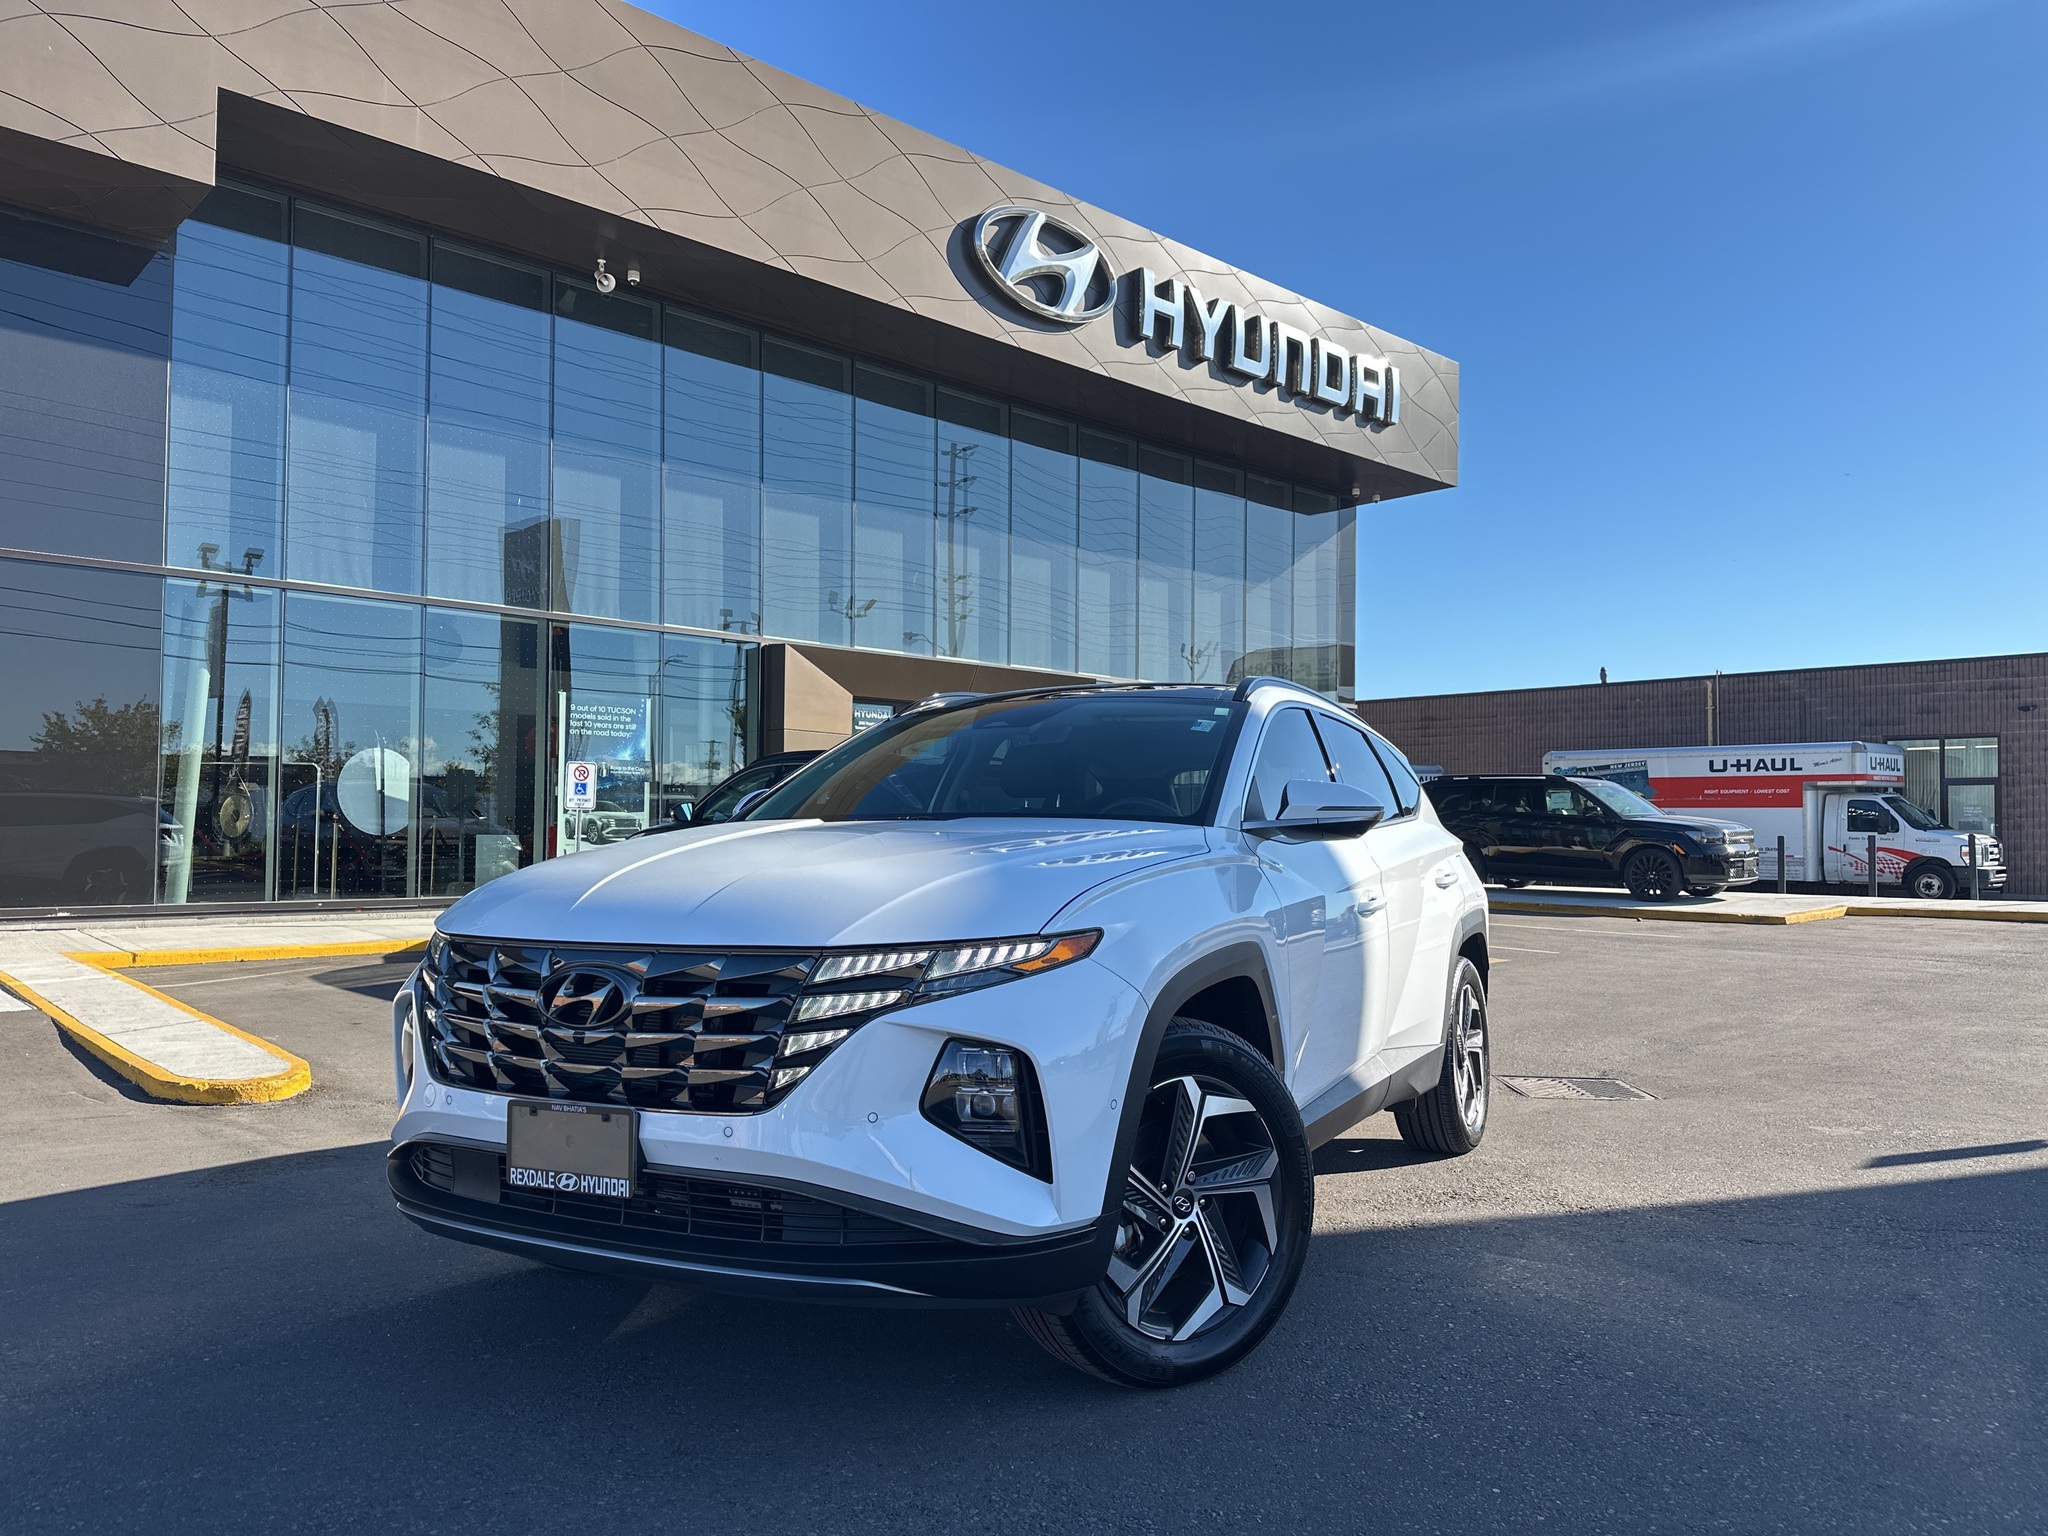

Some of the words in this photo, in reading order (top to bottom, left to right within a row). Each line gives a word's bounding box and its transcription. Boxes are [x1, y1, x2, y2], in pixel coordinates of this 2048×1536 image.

[1139, 266, 1400, 425] HYUNDAI
[570, 703, 576, 711] 9
[607, 706, 637, 715] TUCSON
[854, 709, 891, 720] HYUNDAI
[570, 712, 597, 720] models
[597, 713, 612, 721] sold
[620, 715, 631, 723] the
[569, 719, 583, 727] last
[584, 720, 592, 728] 10
[593, 721, 612, 729] years
[625, 723, 637, 731] still
[580, 728, 592, 736] the
[593, 729, 610, 737] road
[1708, 757, 1803, 773] U-HAUL
[1869, 756, 1901, 772] U-HAUL
[1239, 1056, 1298, 1132] MICHELIN
[551, 1104, 564, 1112] NAV
[563, 1105, 587, 1114] BHATIA'S
[510, 1167, 555, 1189] REXDALE
[580, 1174, 630, 1198] HYUNDAI
[1299, 1147, 1310, 1207] PRIMACY
